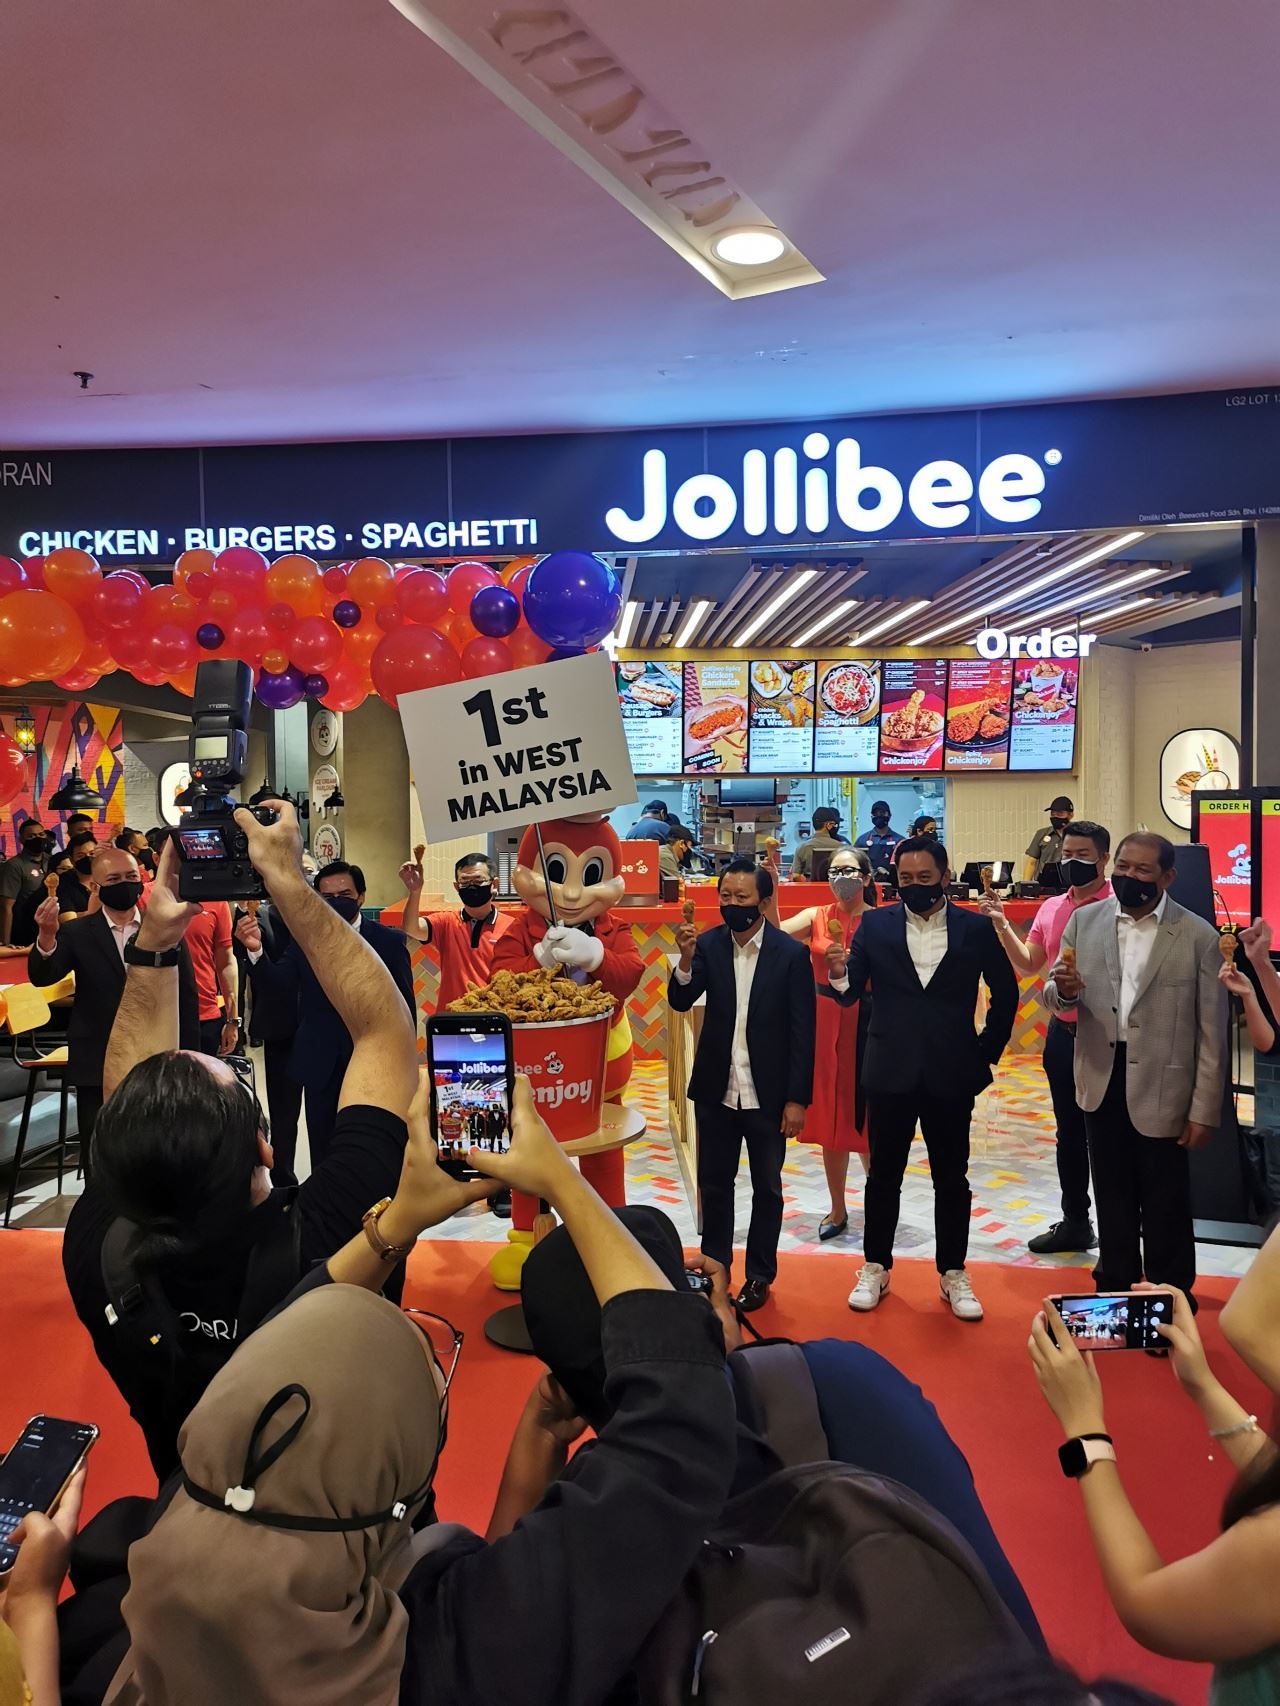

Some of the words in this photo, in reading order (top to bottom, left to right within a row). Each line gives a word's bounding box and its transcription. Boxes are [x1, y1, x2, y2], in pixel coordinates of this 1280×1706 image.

[1225, 396, 1246, 407] LG2
[1249, 394, 1270, 405] LOT
[0, 461, 52, 486] RAN
[605, 432, 1046, 543] Jollibee
[19, 529, 158, 556] CHICKEN
[185, 525, 336, 552] BURGERS
[361, 519, 538, 549] SPAGHETTI
[976, 628, 1097, 659] Order
[463, 687, 548, 747] 1st
[818, 717, 859, 727] Spaghetti
[458, 760, 489, 785] in
[493, 737, 583, 777] WEST
[447, 769, 612, 823] MALAYSIA
